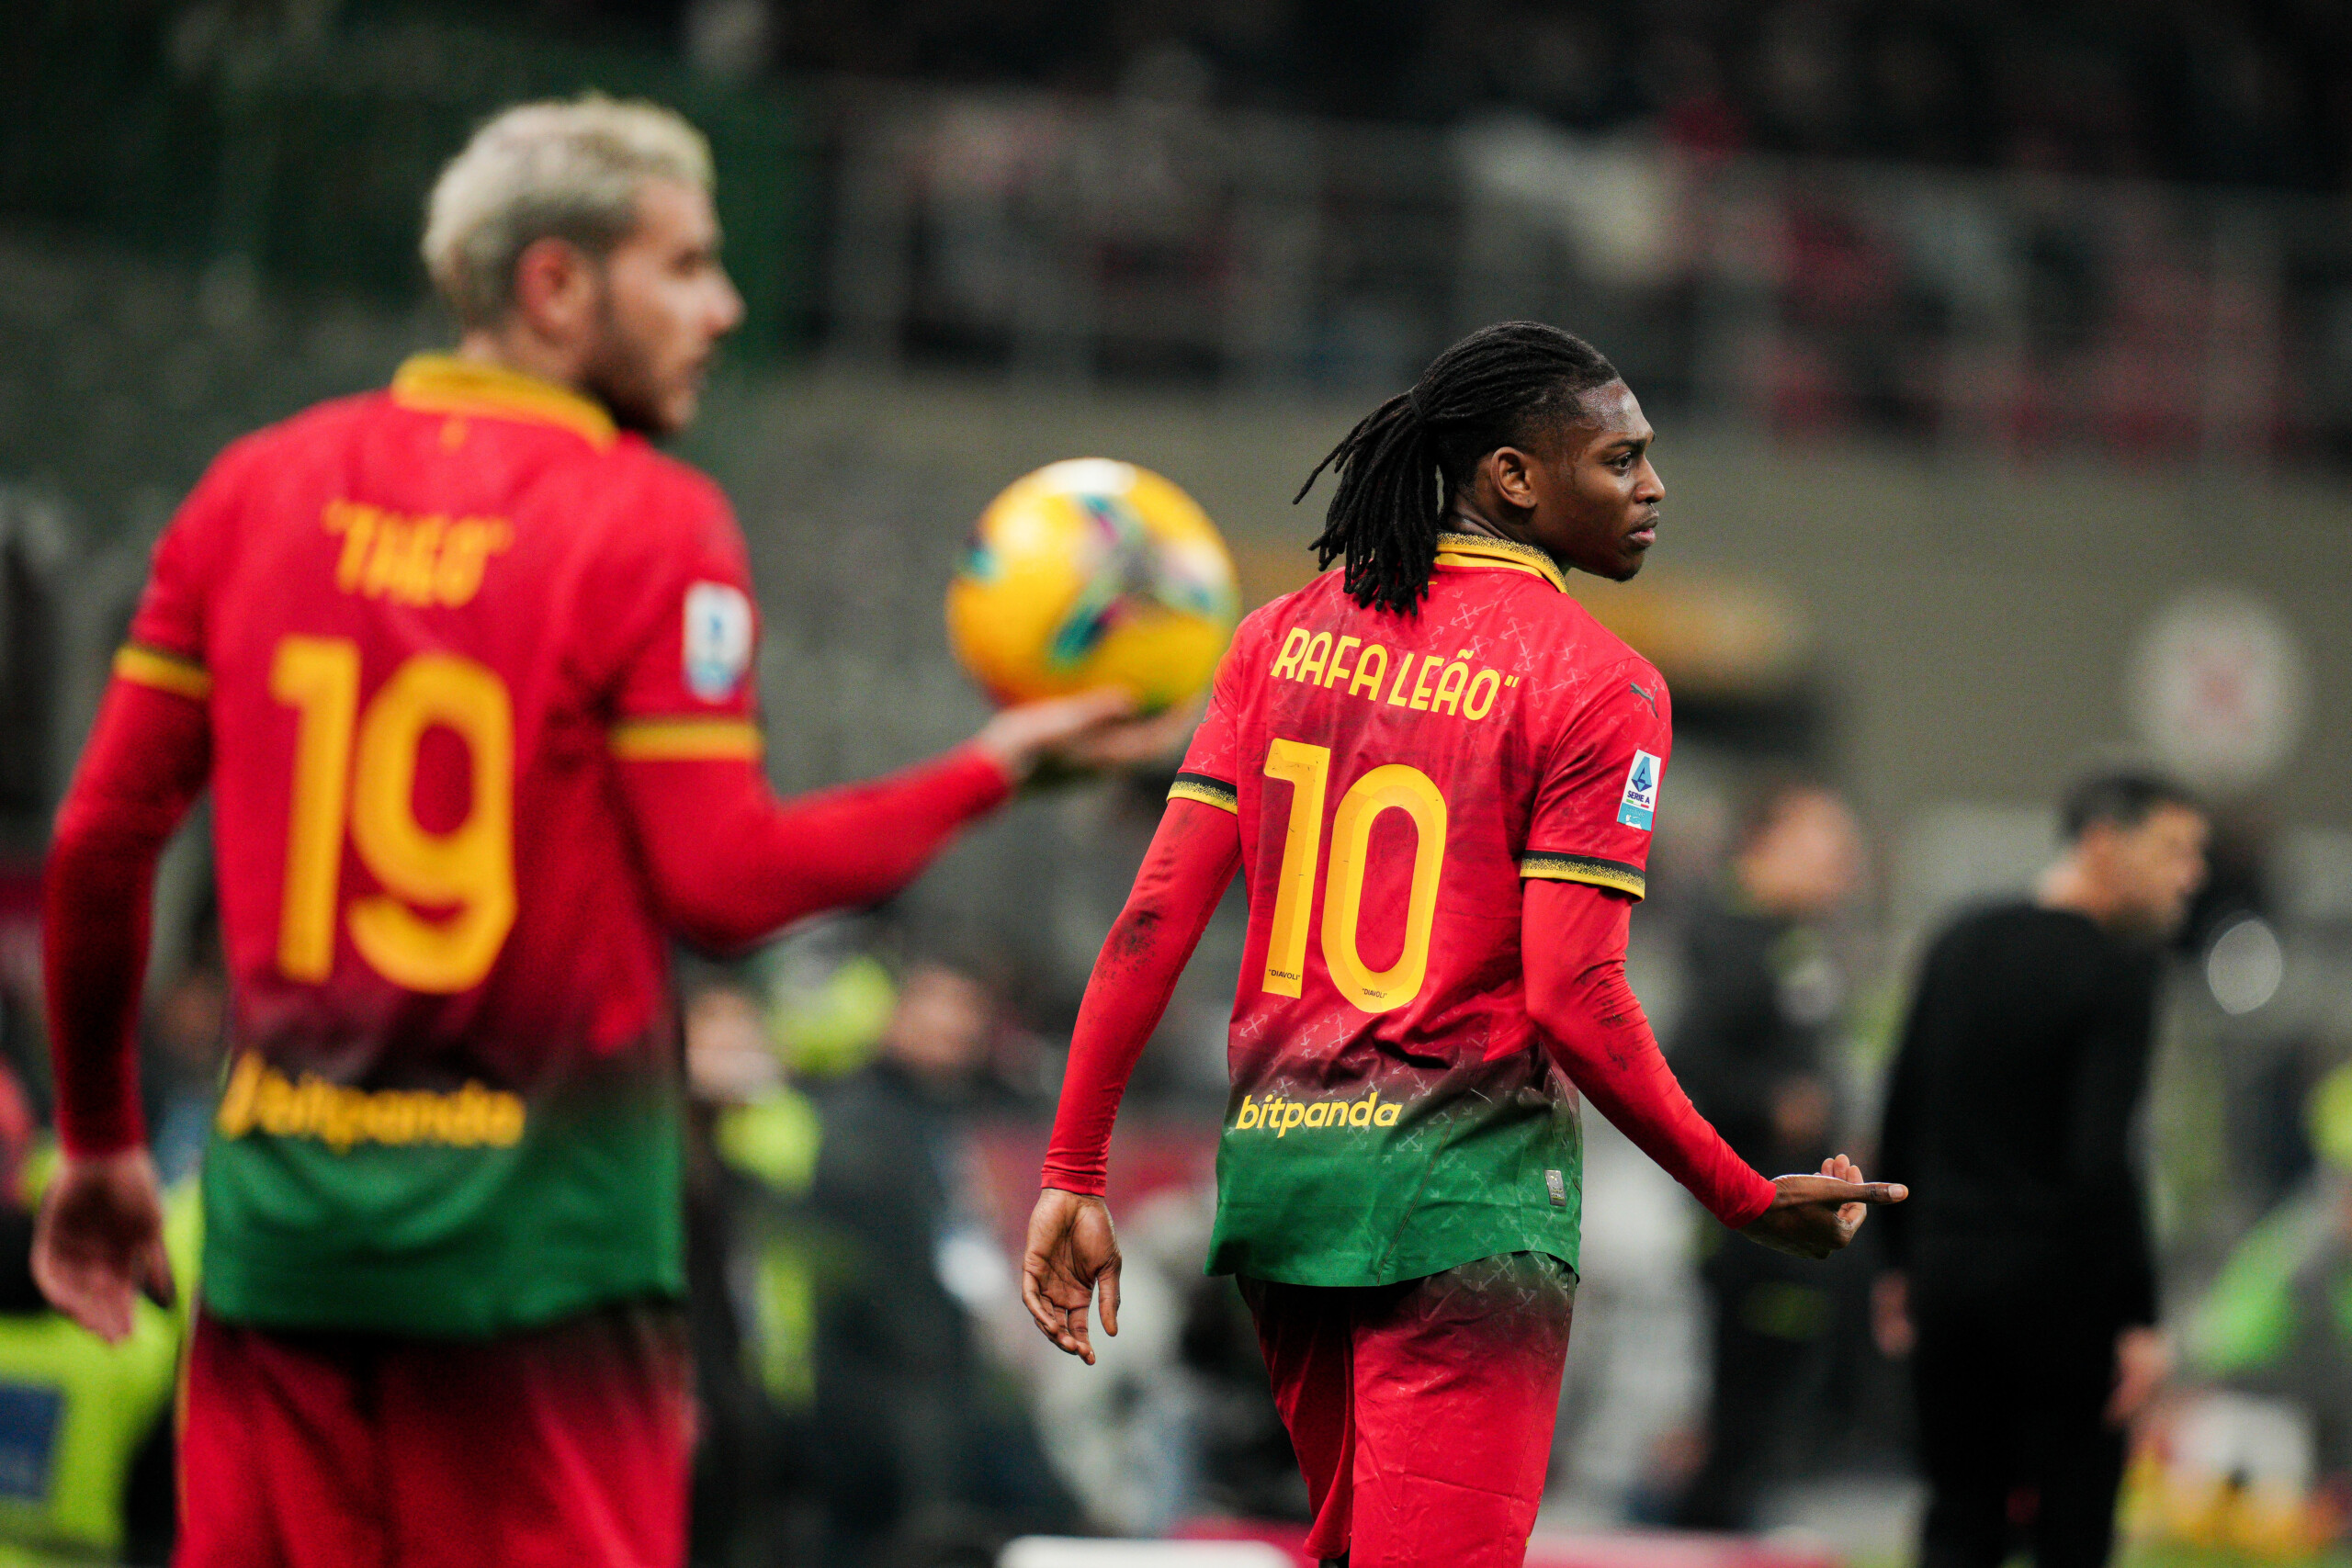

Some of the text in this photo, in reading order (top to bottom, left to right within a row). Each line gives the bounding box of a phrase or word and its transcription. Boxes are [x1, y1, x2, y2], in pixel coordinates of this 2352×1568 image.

[1271, 627, 1388, 701] RAFA
[273, 637, 515, 993] 19
[1627, 790, 1650, 805] SERIE A
[1261, 738, 1448, 1013] 10
[1268, 968, 1301, 981] "DIAVOLI"
[1362, 987, 1388, 999] "DIAVOLI"
[1235, 1091, 1403, 1138] bitpanda
